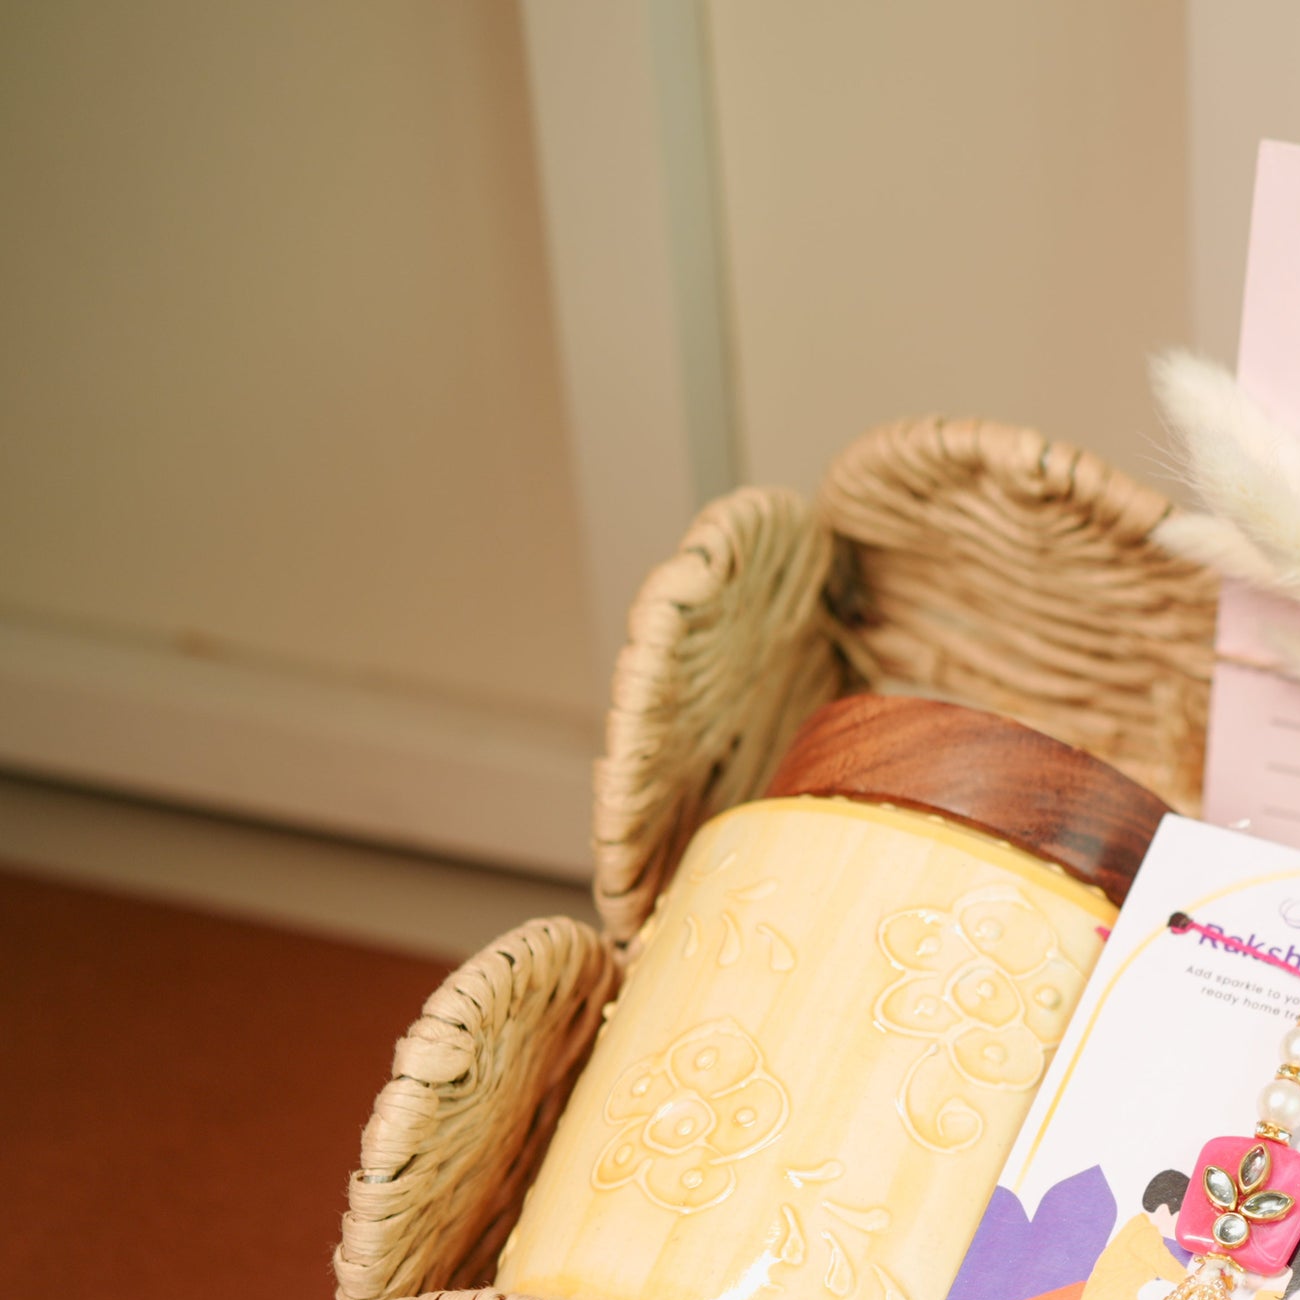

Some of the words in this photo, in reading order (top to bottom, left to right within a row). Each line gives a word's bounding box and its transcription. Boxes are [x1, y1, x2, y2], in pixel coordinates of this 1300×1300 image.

[1185, 965, 1213, 981] Add
[1215, 974, 1264, 994] sparkle
[1267, 988, 1281, 1000] to
[1201, 986, 1239, 1006] ready
[1243, 997, 1281, 1016] home
